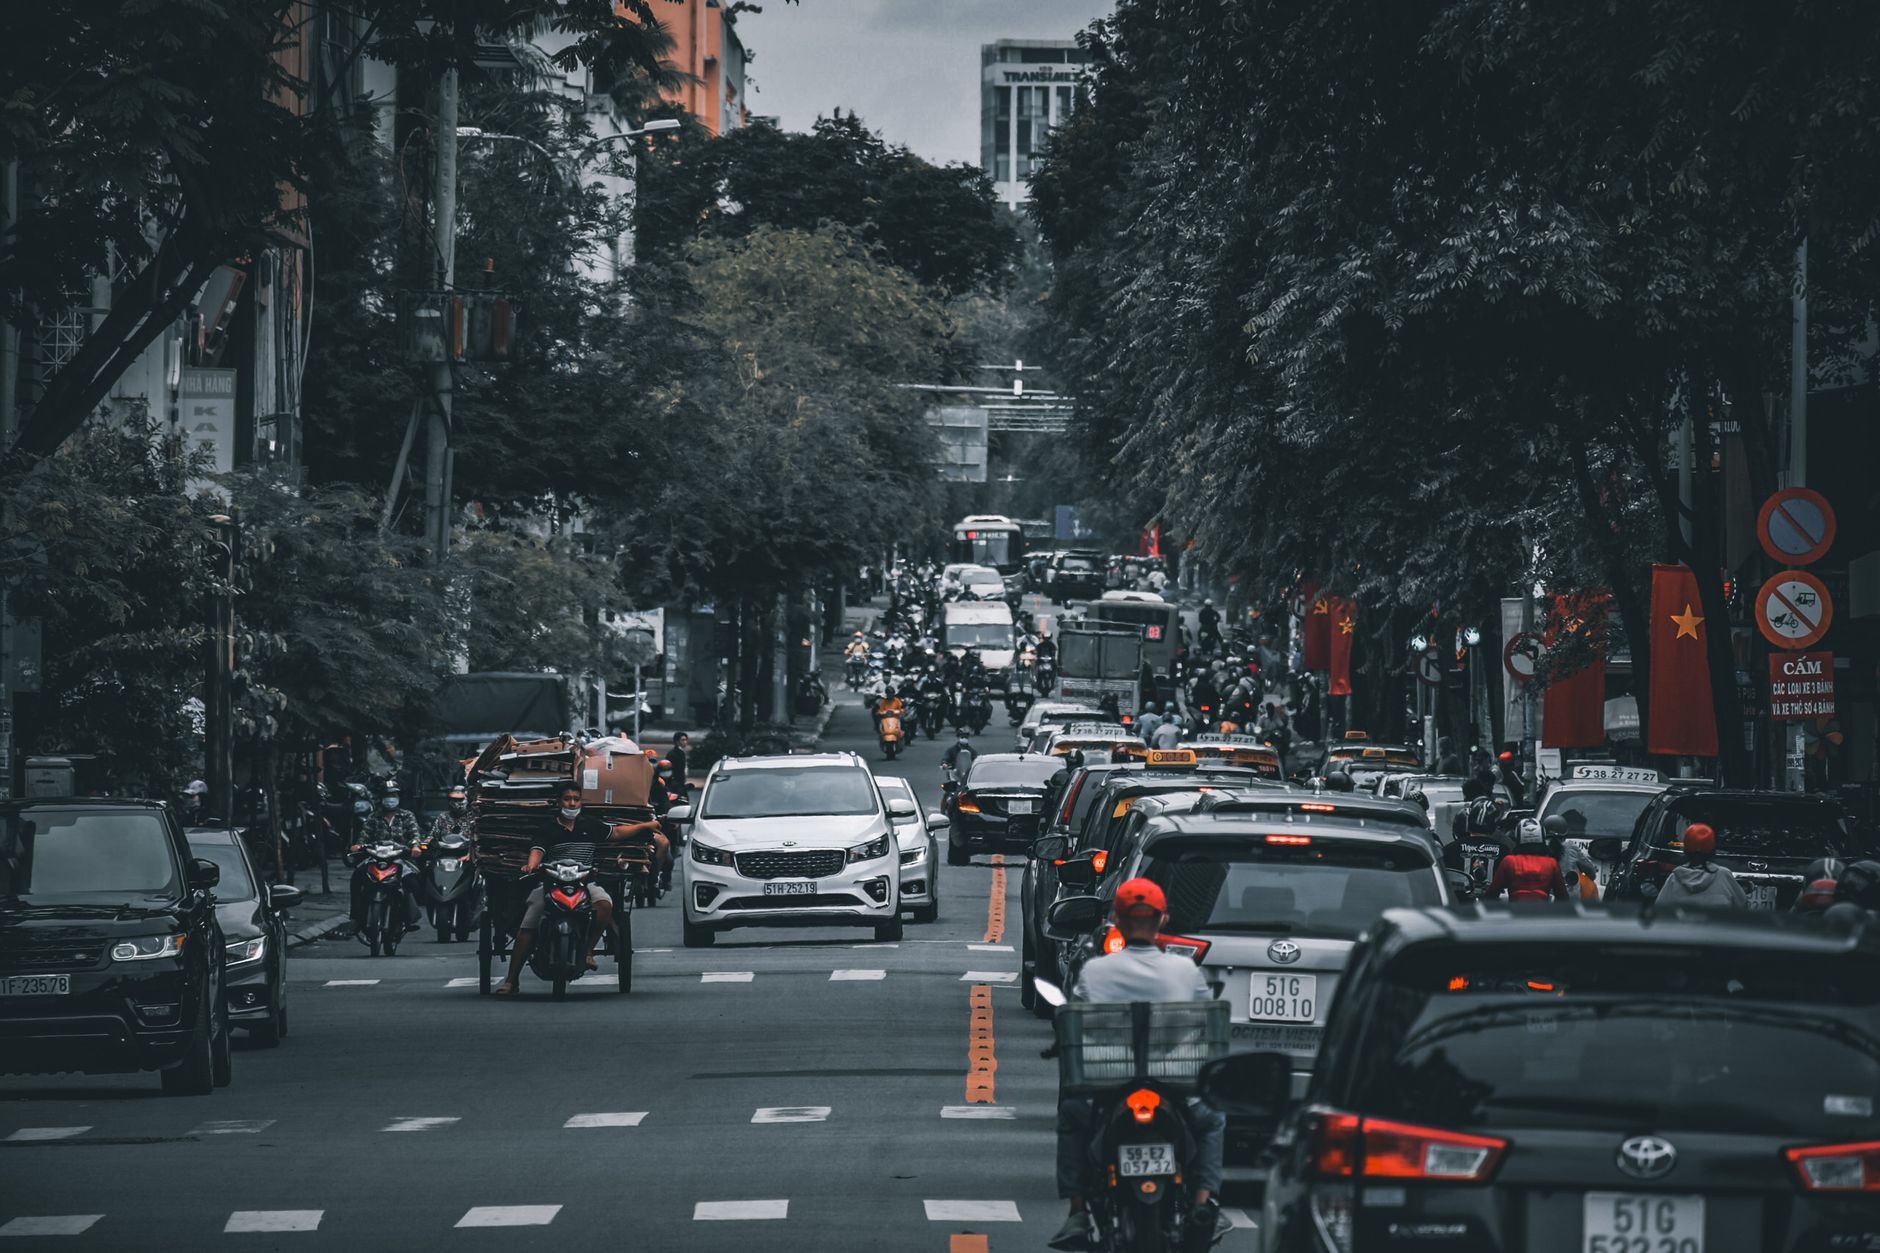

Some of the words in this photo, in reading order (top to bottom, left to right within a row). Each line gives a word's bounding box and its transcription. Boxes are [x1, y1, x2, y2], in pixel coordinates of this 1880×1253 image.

[1783, 656, 1822, 675] CẤM
[1773, 680, 1785, 696] CÁC
[1803, 682, 1811, 695] XE
[1782, 702, 1790, 715] XE
[1628, 772, 1639, 780] 27
[1643, 773, 1656, 781] 27
[1267, 977, 1300, 996] 51G
[1253, 997, 1312, 1018] 008.10
[1614, 1198, 1675, 1234] 51G
